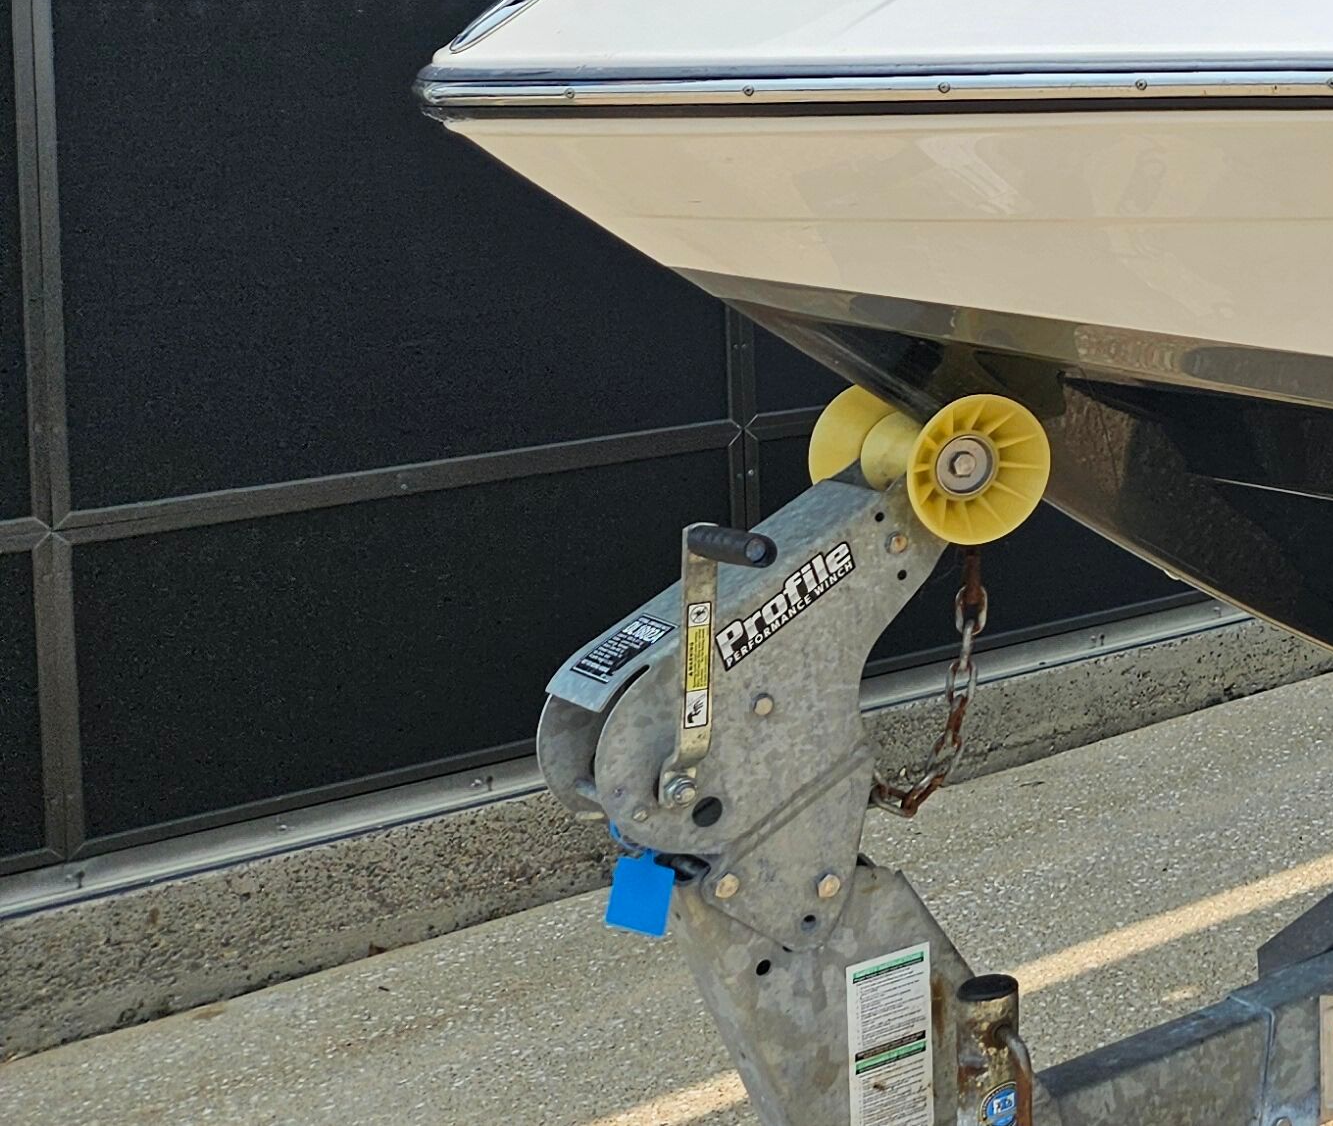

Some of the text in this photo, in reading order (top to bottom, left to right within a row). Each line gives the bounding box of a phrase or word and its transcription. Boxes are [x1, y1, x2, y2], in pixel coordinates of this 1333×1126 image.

[715, 542, 851, 661] Profile
[726, 593, 812, 668] PERFORMANCE
[814, 561, 853, 596] WINCH
